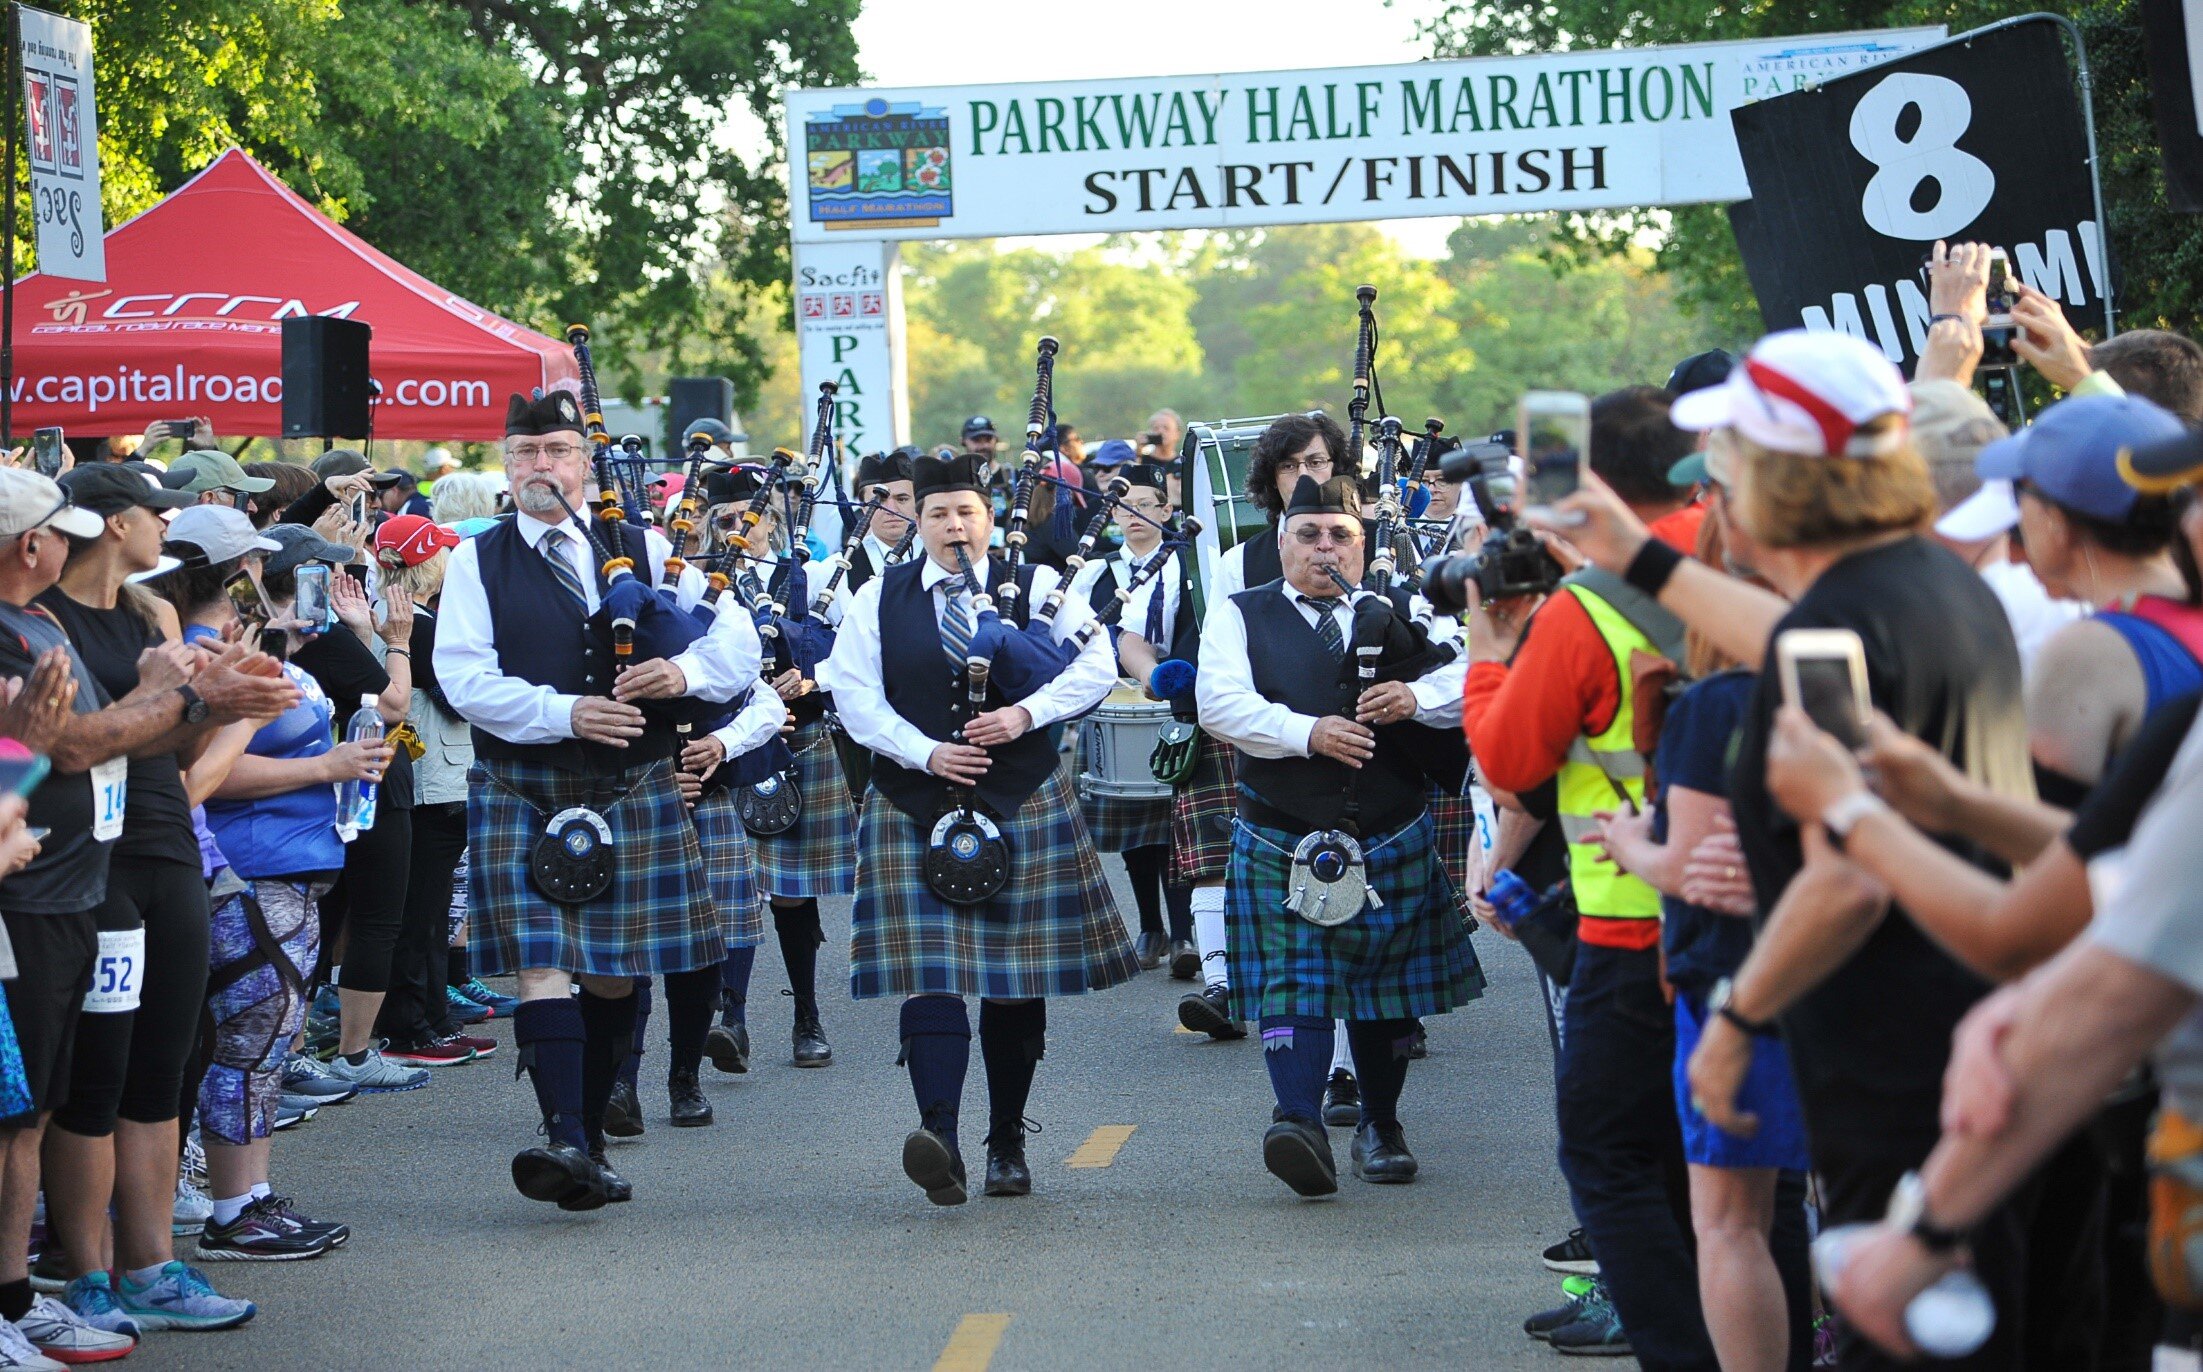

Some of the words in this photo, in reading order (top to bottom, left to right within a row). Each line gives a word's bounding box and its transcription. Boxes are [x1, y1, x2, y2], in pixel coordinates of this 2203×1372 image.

[1743, 56, 1847, 73] AMERICAN
[969, 89, 1229, 156] PARKWAY
[1245, 81, 1382, 143] HALF
[1400, 62, 1714, 136] MARATHON
[808, 131, 948, 150] PARKWAY
[1849, 72, 1996, 241] 8
[1084, 146, 1608, 214] START/FINISH
[801, 265, 879, 286] Sacfit
